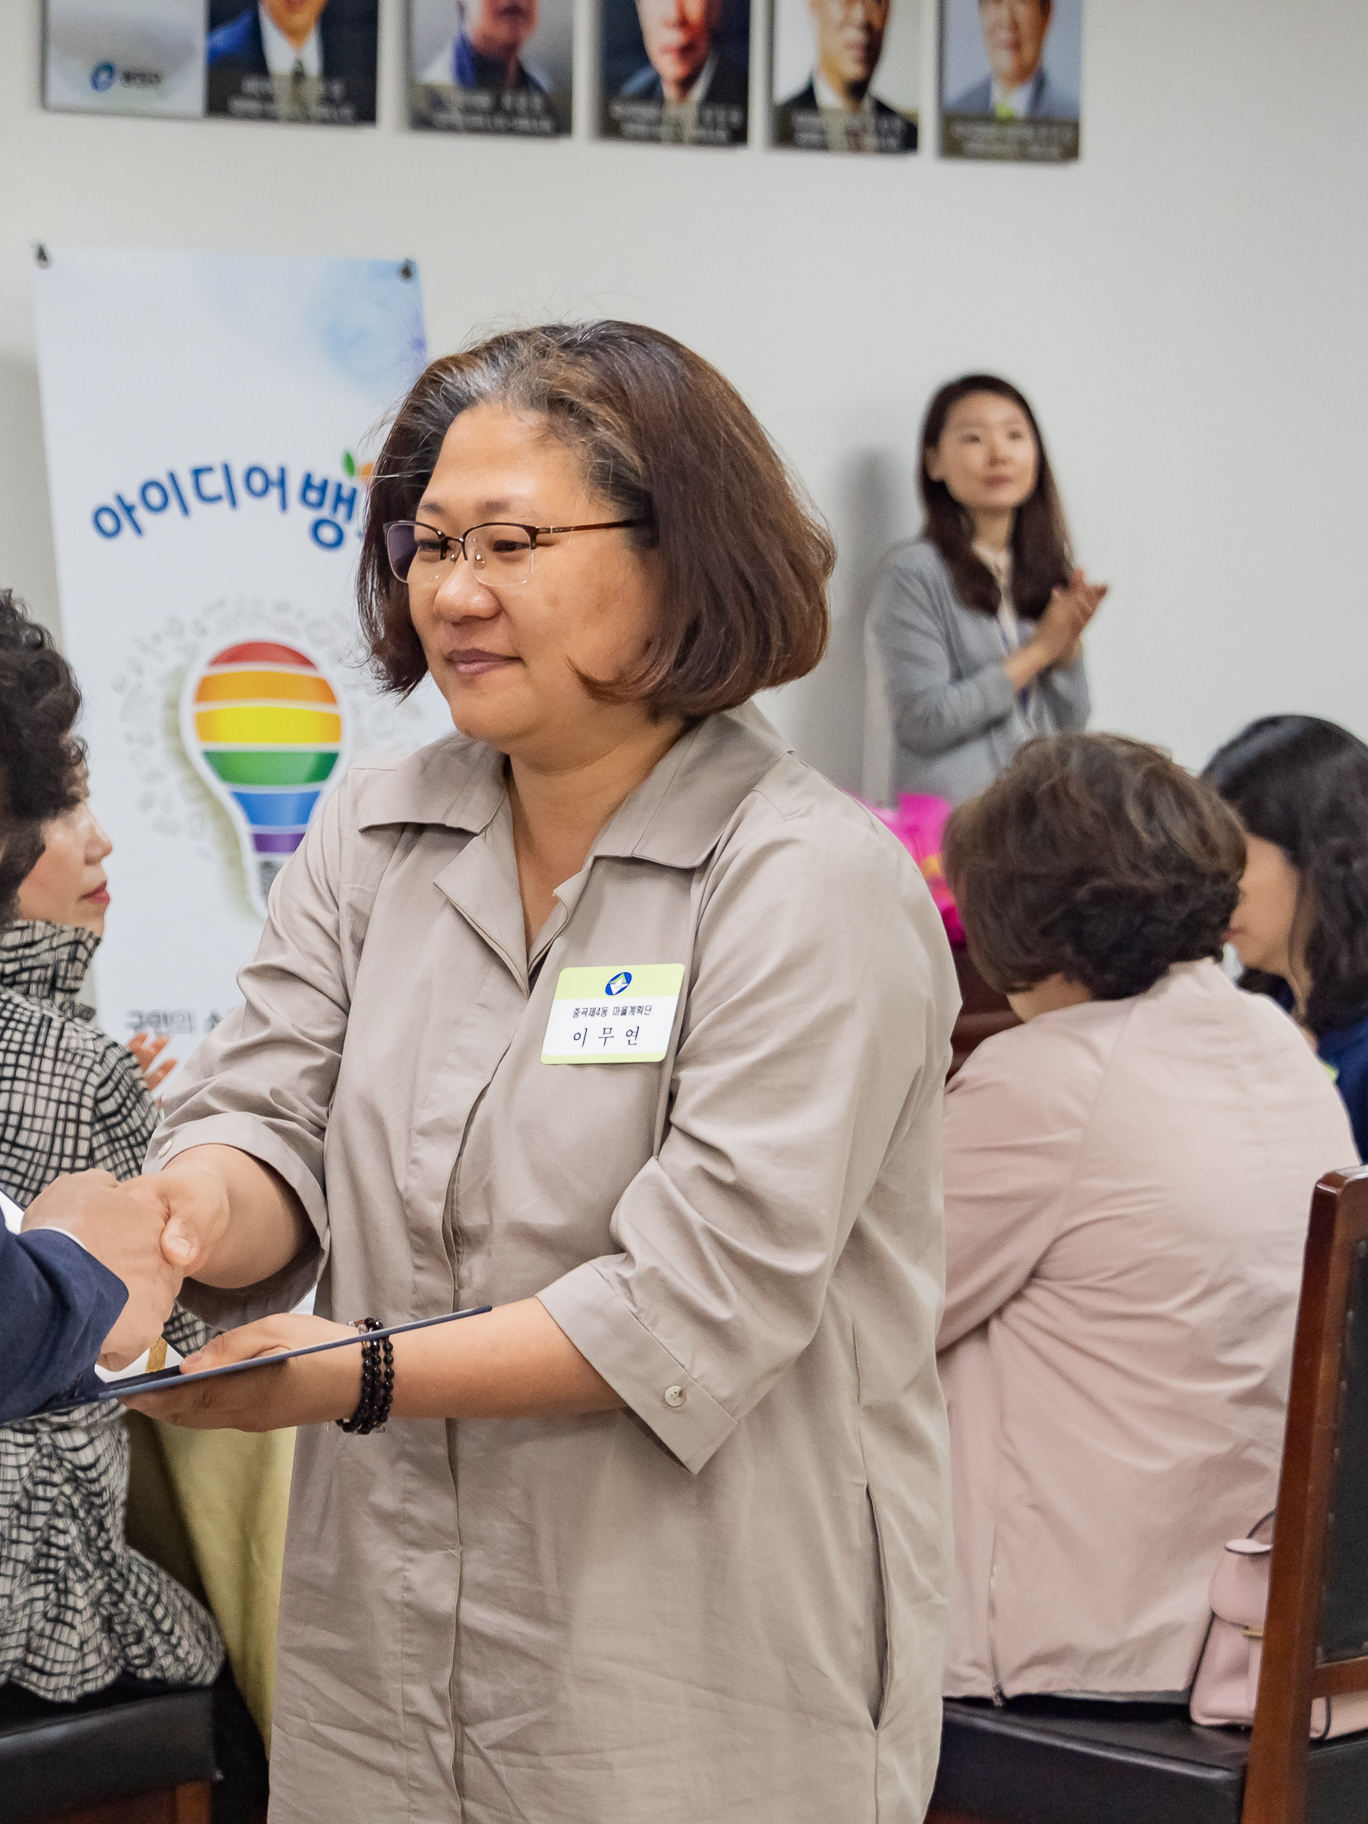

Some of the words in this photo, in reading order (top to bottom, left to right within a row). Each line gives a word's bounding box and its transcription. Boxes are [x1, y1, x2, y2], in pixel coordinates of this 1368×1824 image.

[92, 463, 364, 550] 아이디어뱅
[573, 1007, 608, 1018] 중곡제4동
[614, 1005, 652, 1016] 마을계획단
